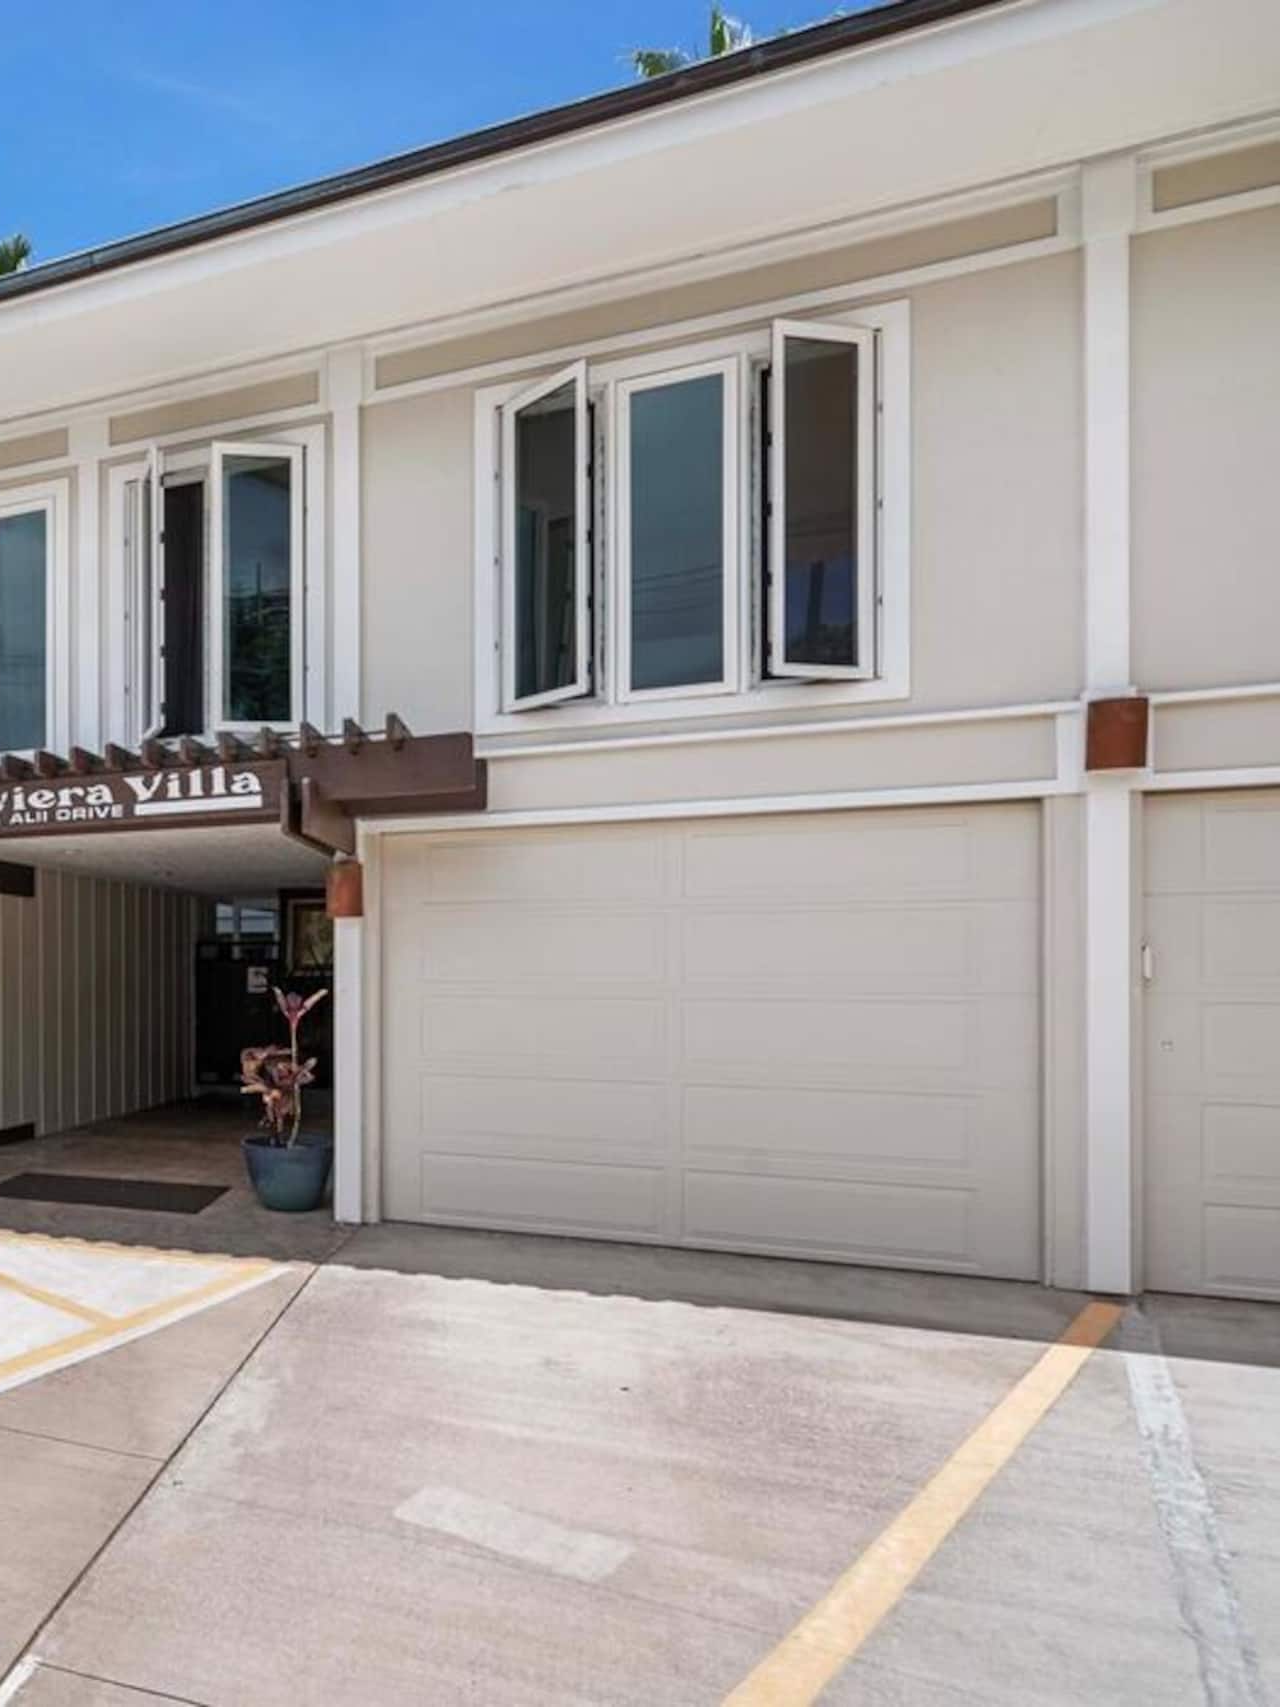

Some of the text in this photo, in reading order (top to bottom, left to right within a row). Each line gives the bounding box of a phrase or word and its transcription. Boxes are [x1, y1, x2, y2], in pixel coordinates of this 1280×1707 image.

[123, 766, 263, 815] Villa
[9, 809, 48, 826] ALII
[55, 803, 124, 822] DRIVE
